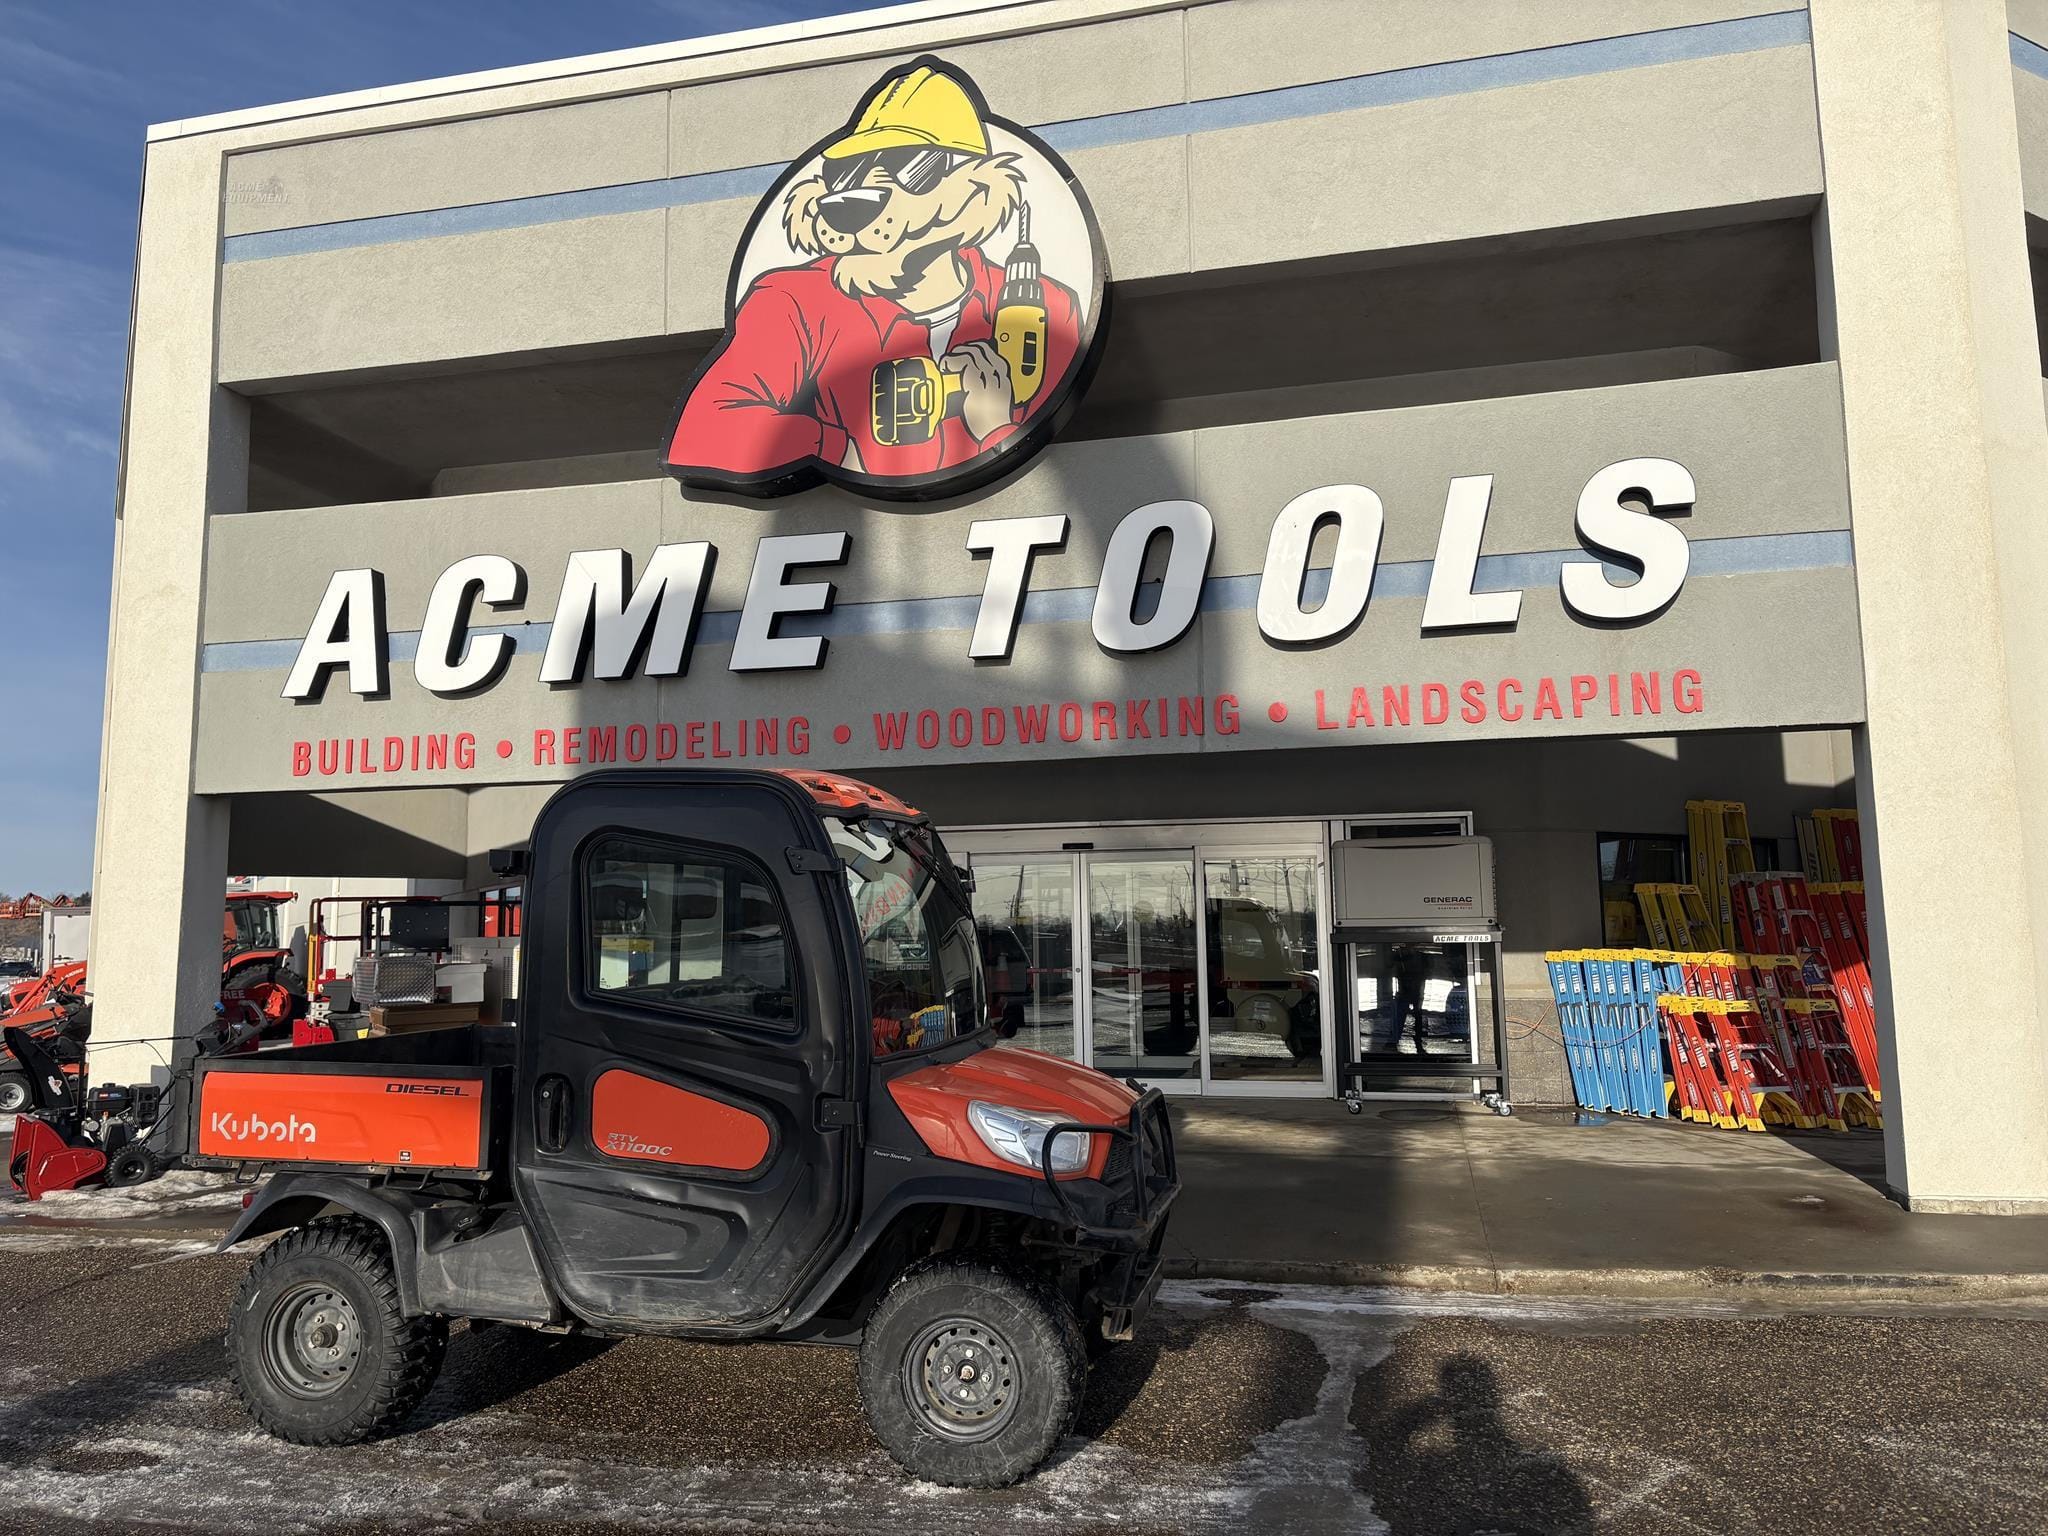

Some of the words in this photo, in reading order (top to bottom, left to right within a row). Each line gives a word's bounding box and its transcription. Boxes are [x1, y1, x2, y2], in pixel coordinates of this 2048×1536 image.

[280, 530, 851, 700] ACME
[965, 457, 1697, 659] TOOLS
[292, 732, 476, 776] BUILDING
[533, 715, 810, 765] REMODELING
[873, 694, 1240, 750] WOODWORKING
[1315, 669, 1703, 729] LANDSCAPING
[386, 1083, 469, 1096] DIESEL
[211, 1112, 317, 1142] Kubota
[607, 1132, 639, 1142] RTV
[604, 1140, 673, 1156] X1100C
[890, 1153, 912, 1161] Steering
